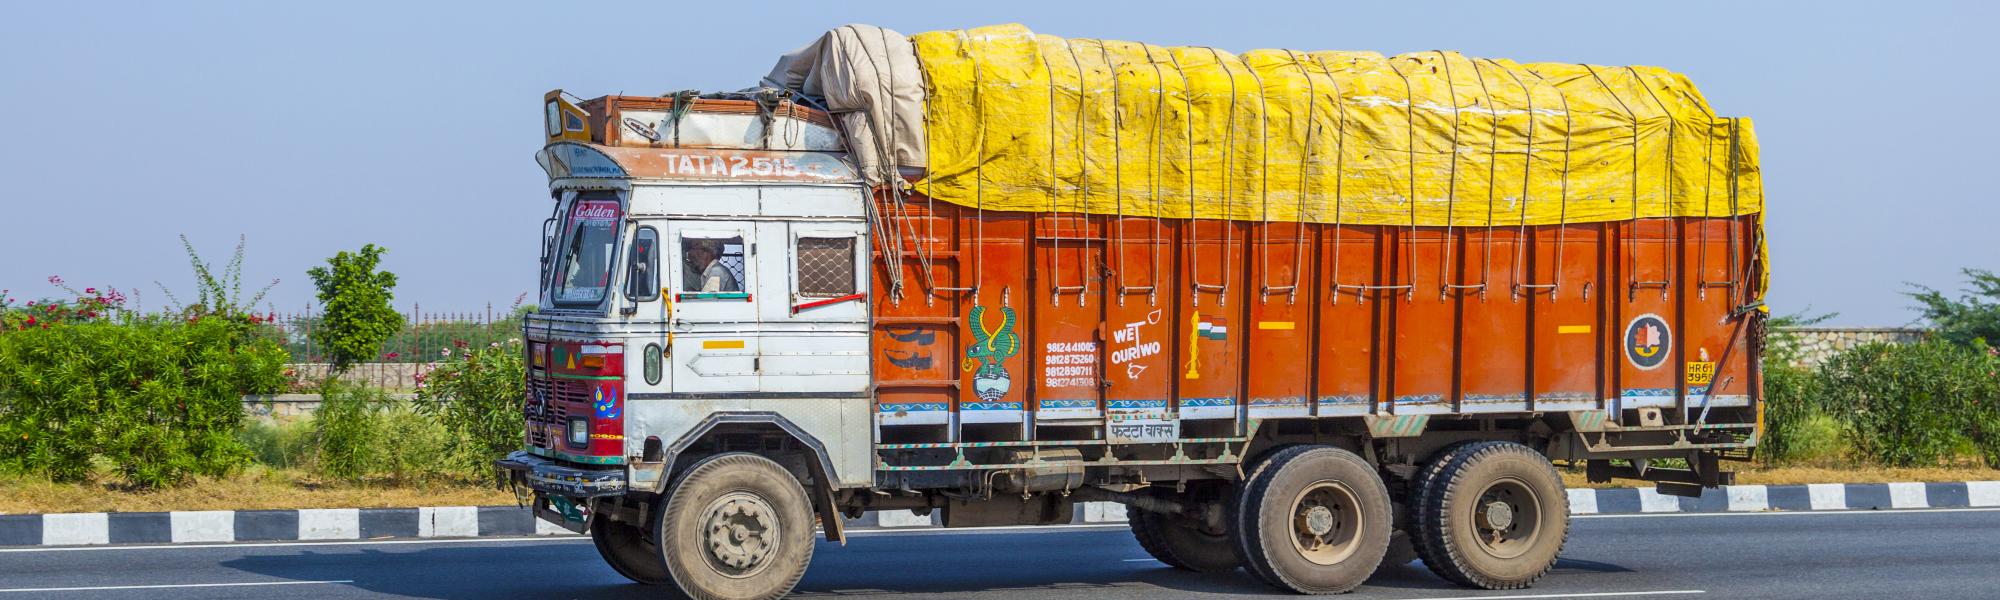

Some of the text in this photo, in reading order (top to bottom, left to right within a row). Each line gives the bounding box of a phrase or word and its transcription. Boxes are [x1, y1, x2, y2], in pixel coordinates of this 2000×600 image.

[660, 153, 802, 177] TATA 2515
[576, 204, 615, 218] Golden
